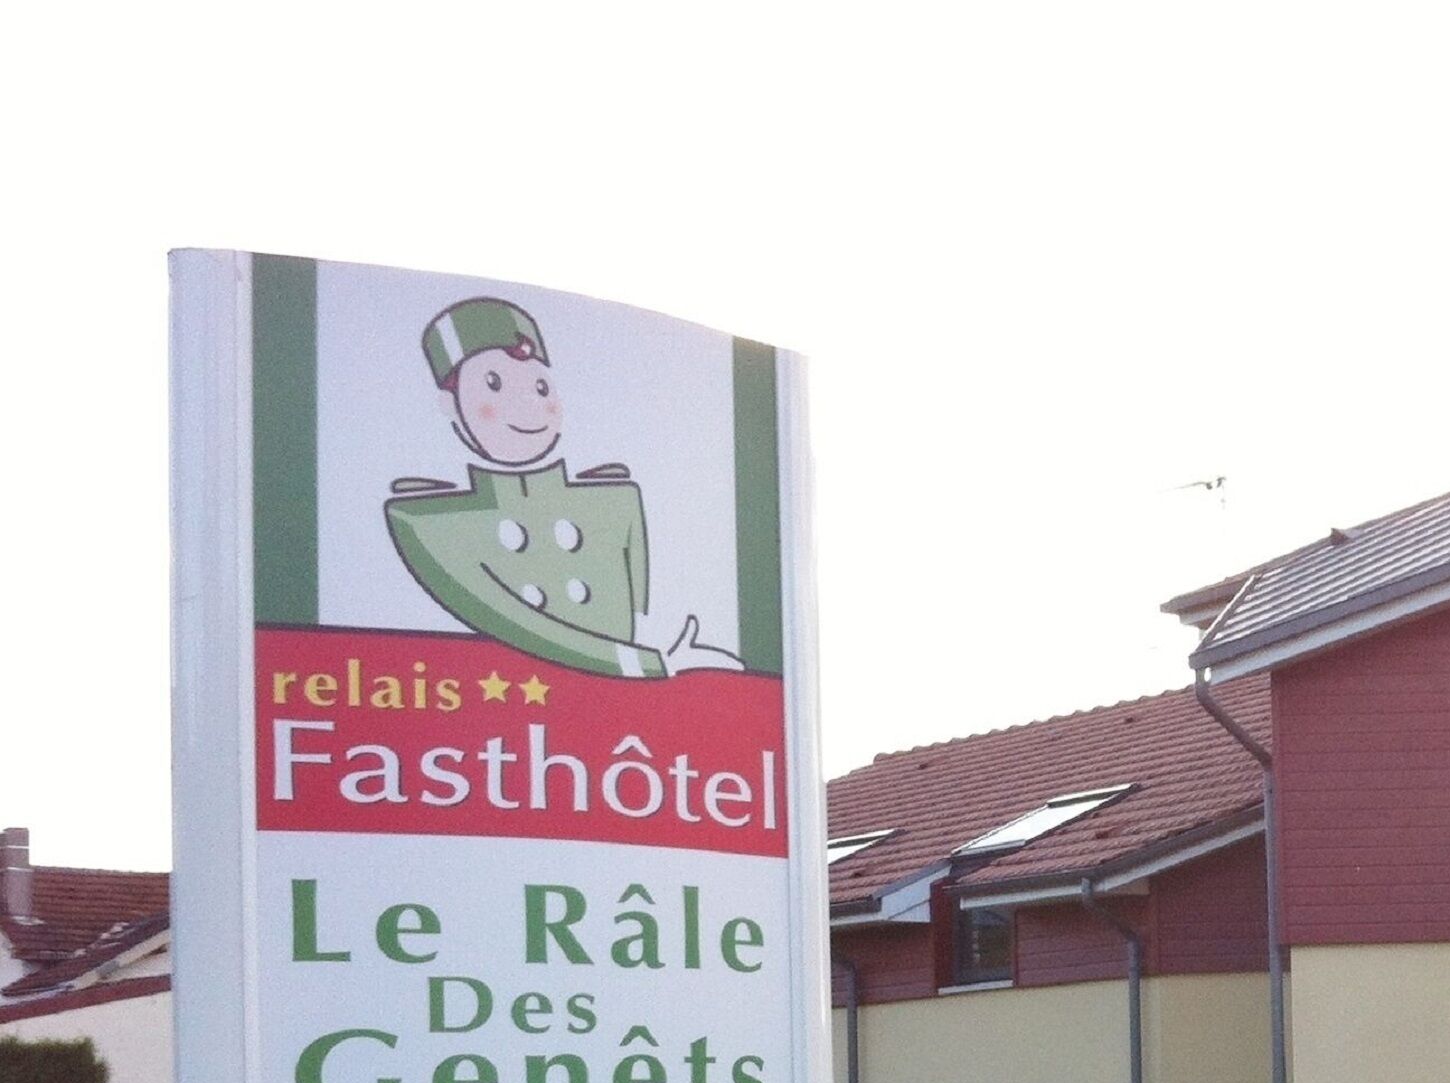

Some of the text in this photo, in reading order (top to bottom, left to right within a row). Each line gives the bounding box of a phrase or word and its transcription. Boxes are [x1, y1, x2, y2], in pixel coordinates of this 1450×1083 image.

[272, 658, 462, 711] relais
[272, 718, 777, 830] Fasthôtel
[290, 878, 765, 973] Le Râle
[428, 976, 597, 1035] Des
